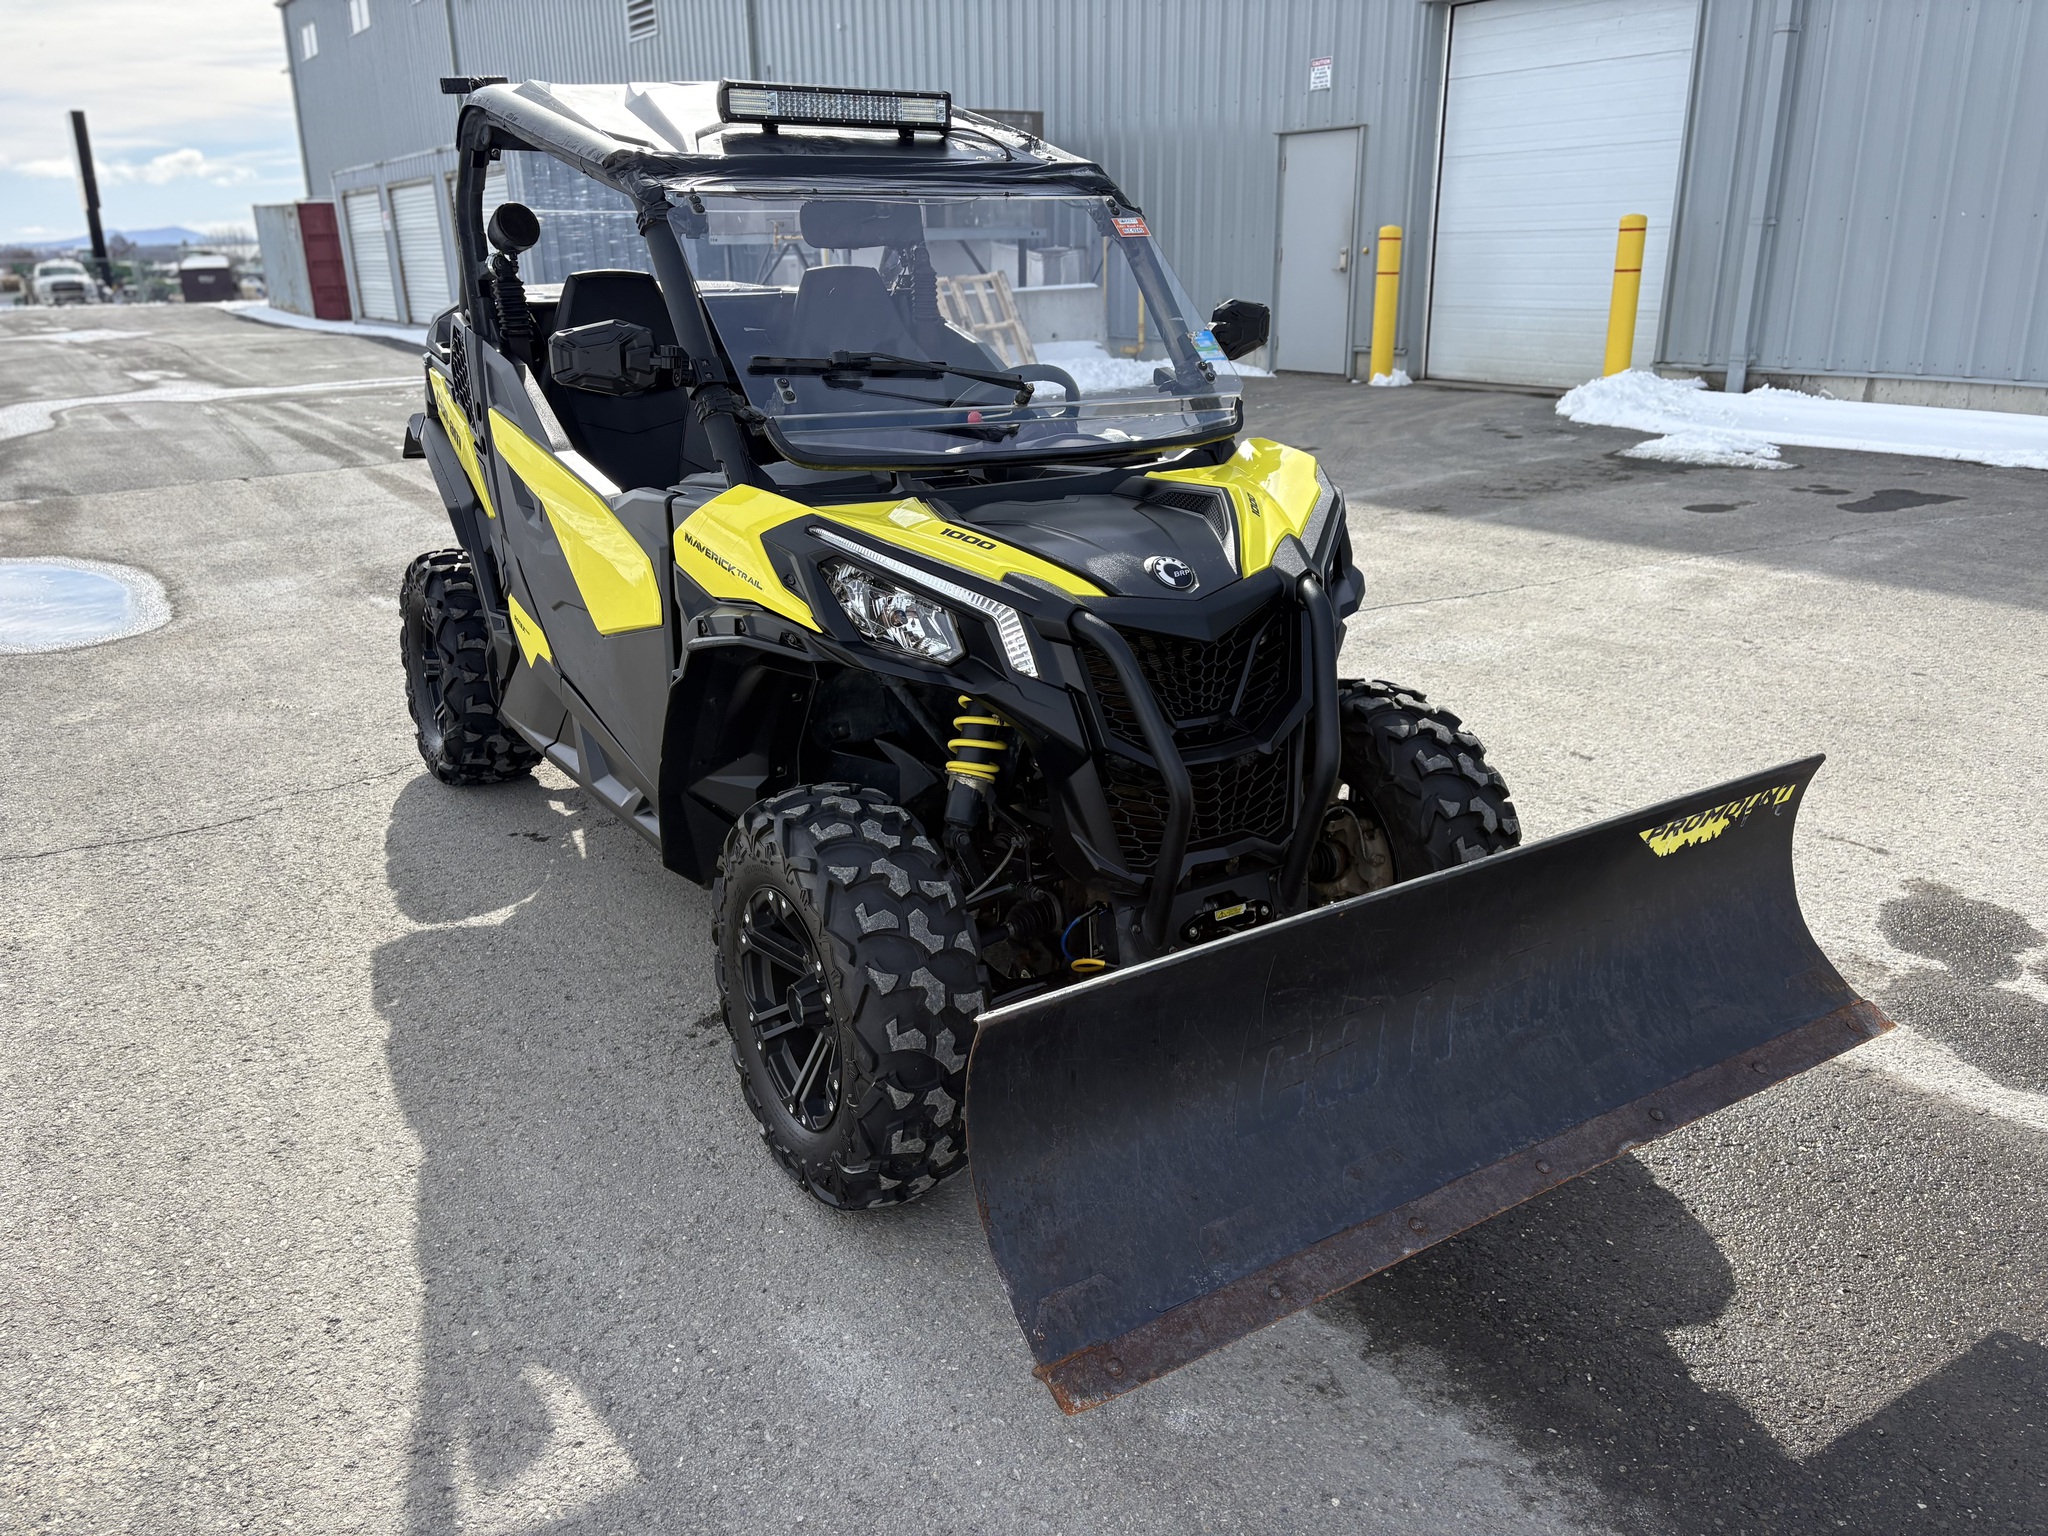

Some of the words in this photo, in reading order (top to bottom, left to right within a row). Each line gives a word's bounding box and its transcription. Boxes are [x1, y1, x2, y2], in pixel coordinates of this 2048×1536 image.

[1247, 492, 1260, 517] 1000
[940, 528, 997, 550] 1000
[684, 532, 736, 576] MAVERICK
[737, 568, 763, 591] TRAIL
[1173, 569, 1190, 578] BRP
